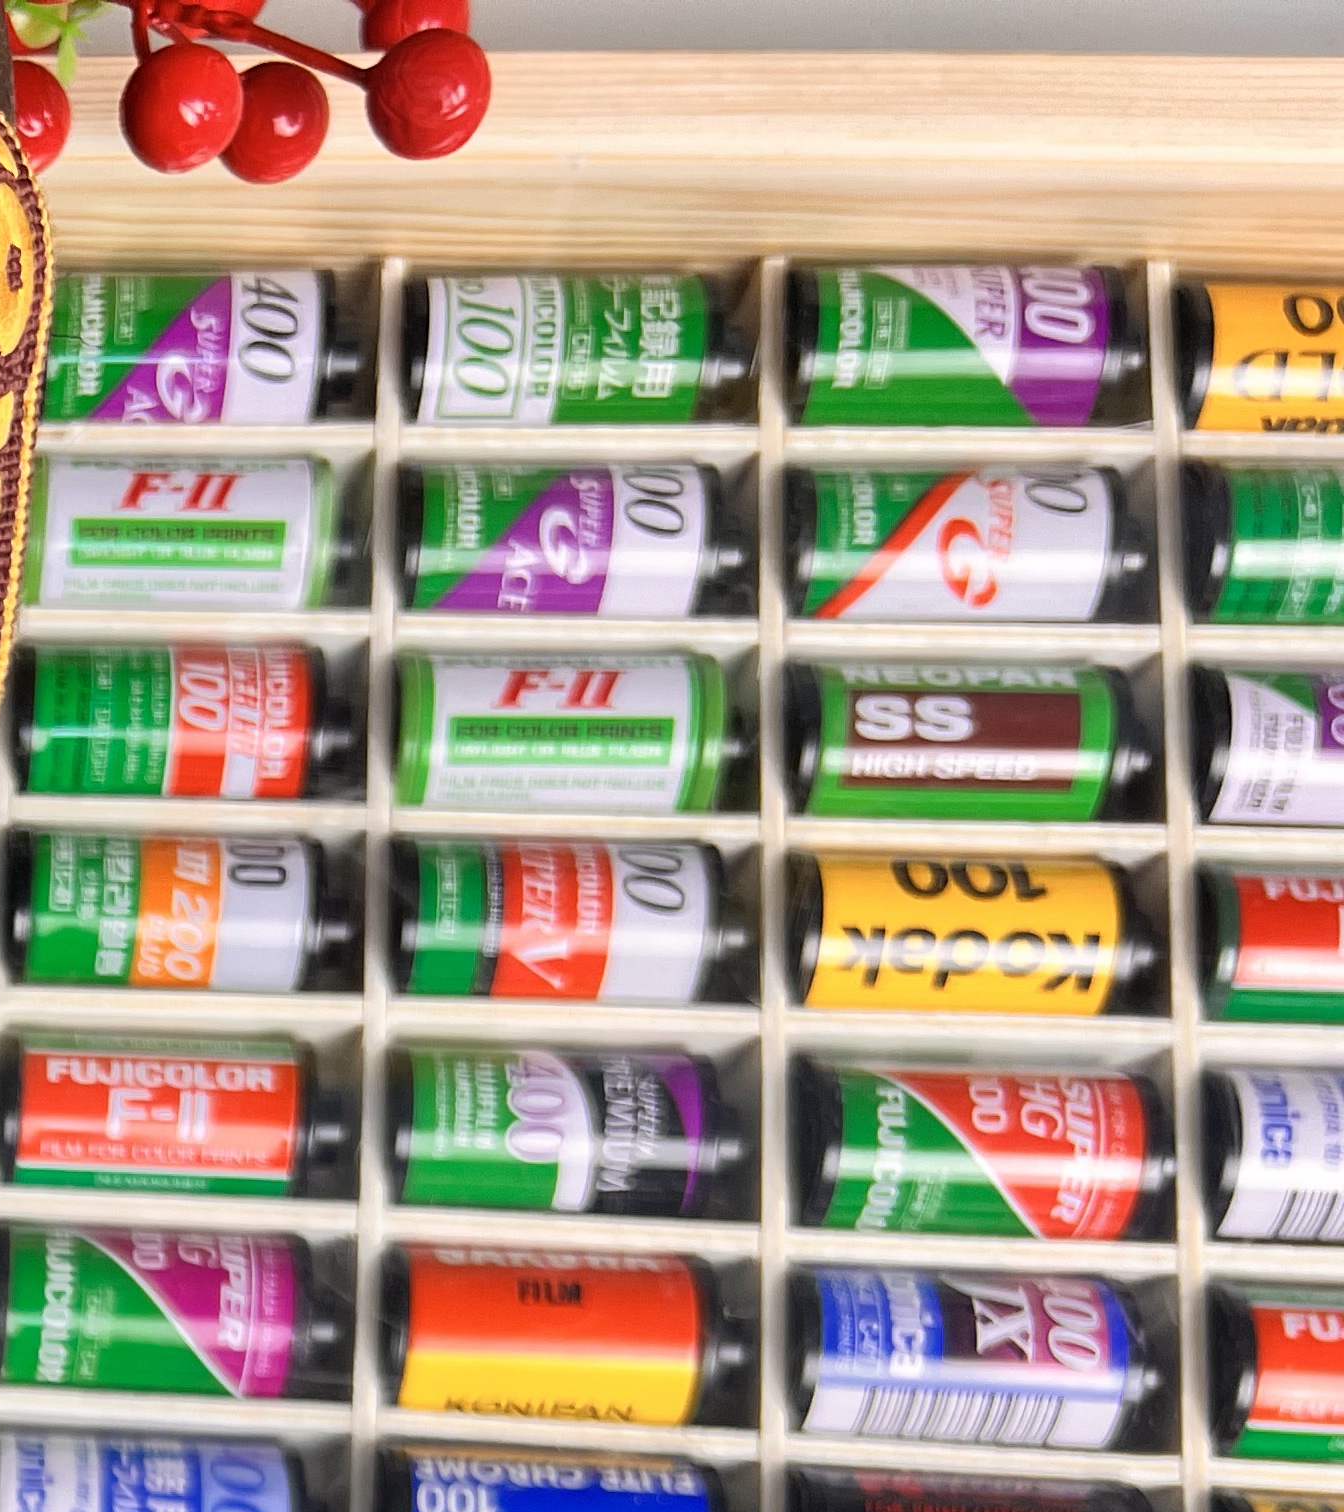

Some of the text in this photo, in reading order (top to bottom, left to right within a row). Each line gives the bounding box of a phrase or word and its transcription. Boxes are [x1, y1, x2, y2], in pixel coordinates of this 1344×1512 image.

[238, 274, 300, 384] 400
[454, 296, 518, 398] 100
[119, 384, 151, 424] AC
[496, 538, 538, 612] ACE
[177, 660, 228, 733] 100
[854, 695, 974, 742] SS
[226, 843, 289, 889] 00
[890, 860, 1047, 902] 100
[164, 888, 210, 981] 200
[838, 925, 1101, 993] Kodak
[45, 1057, 276, 1094] FUJICOLOR
[884, 1273, 934, 1378] onica
